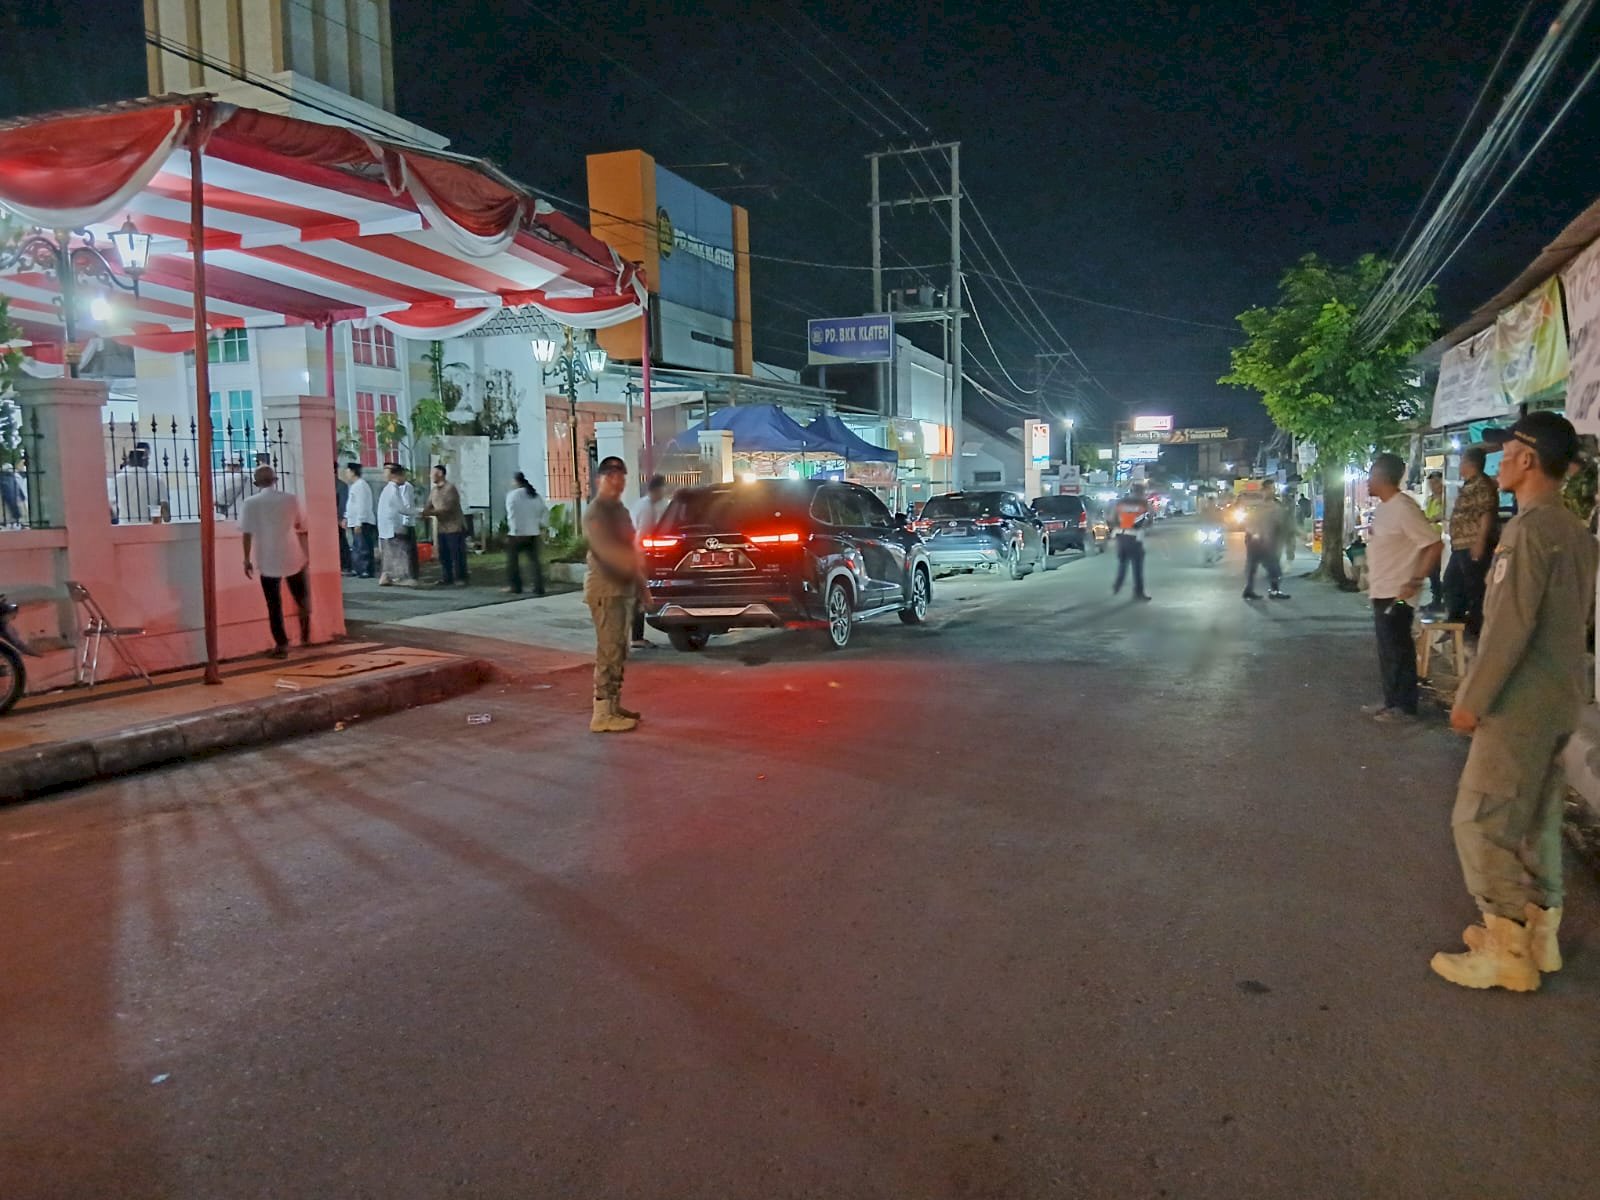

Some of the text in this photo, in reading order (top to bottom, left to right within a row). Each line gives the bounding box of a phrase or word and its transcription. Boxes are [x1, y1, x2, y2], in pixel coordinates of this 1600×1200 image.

[687, 234, 705, 259] BKK
[705, 244, 735, 272] KLATEN
[825, 327, 838, 344] PD.
[839, 326, 856, 343] BKK
[858, 324, 889, 342] KLATEN
